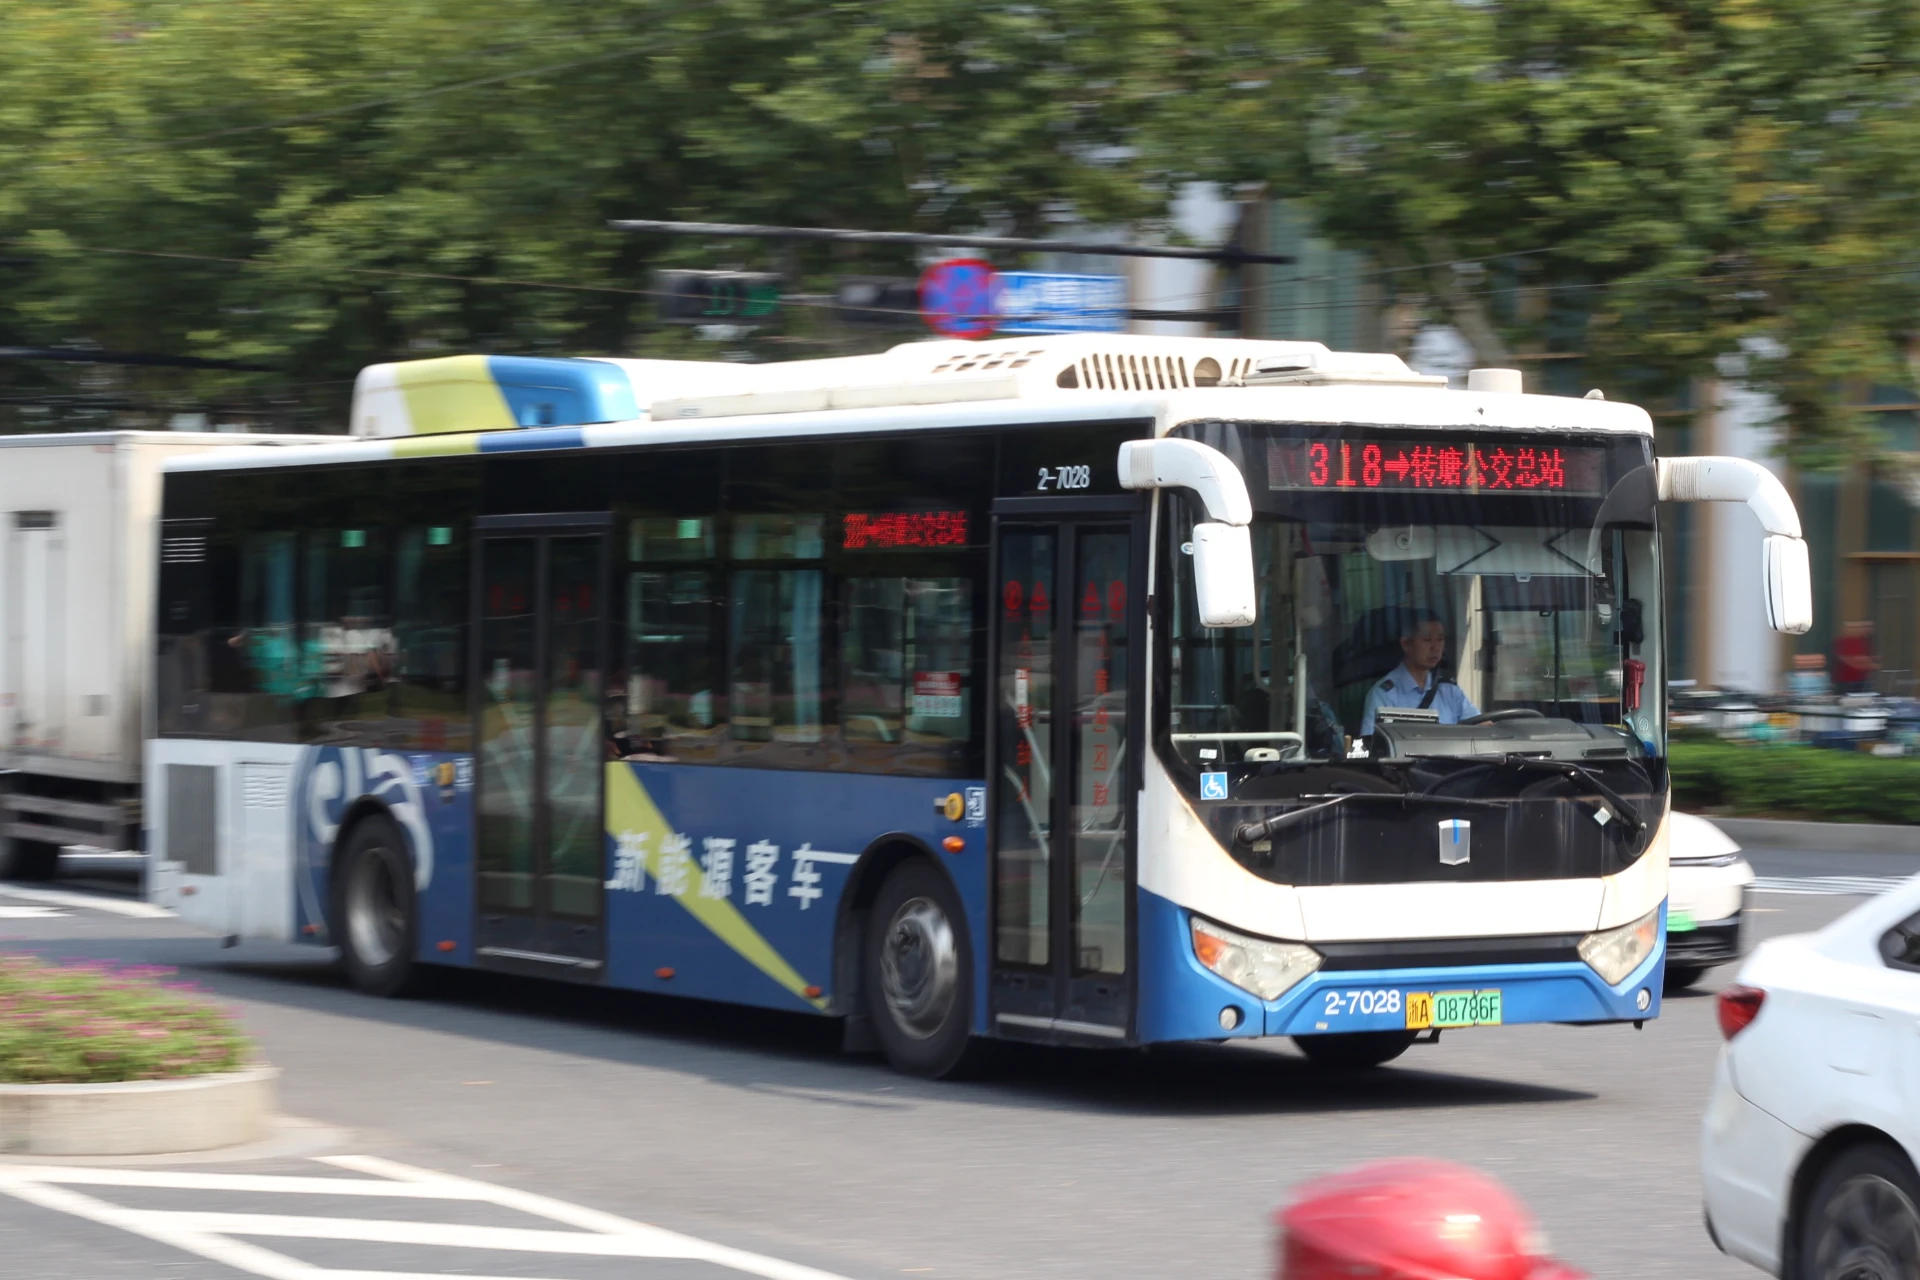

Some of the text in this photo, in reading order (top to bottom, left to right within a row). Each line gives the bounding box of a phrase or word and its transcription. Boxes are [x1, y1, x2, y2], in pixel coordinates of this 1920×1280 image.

[1037, 465, 1090, 490] 2-7028
[1309, 443, 1565, 488] 318 转塘公交总站
[604, 829, 861, 910] 新能源客车
[1325, 989, 1400, 1016] 2-7028
